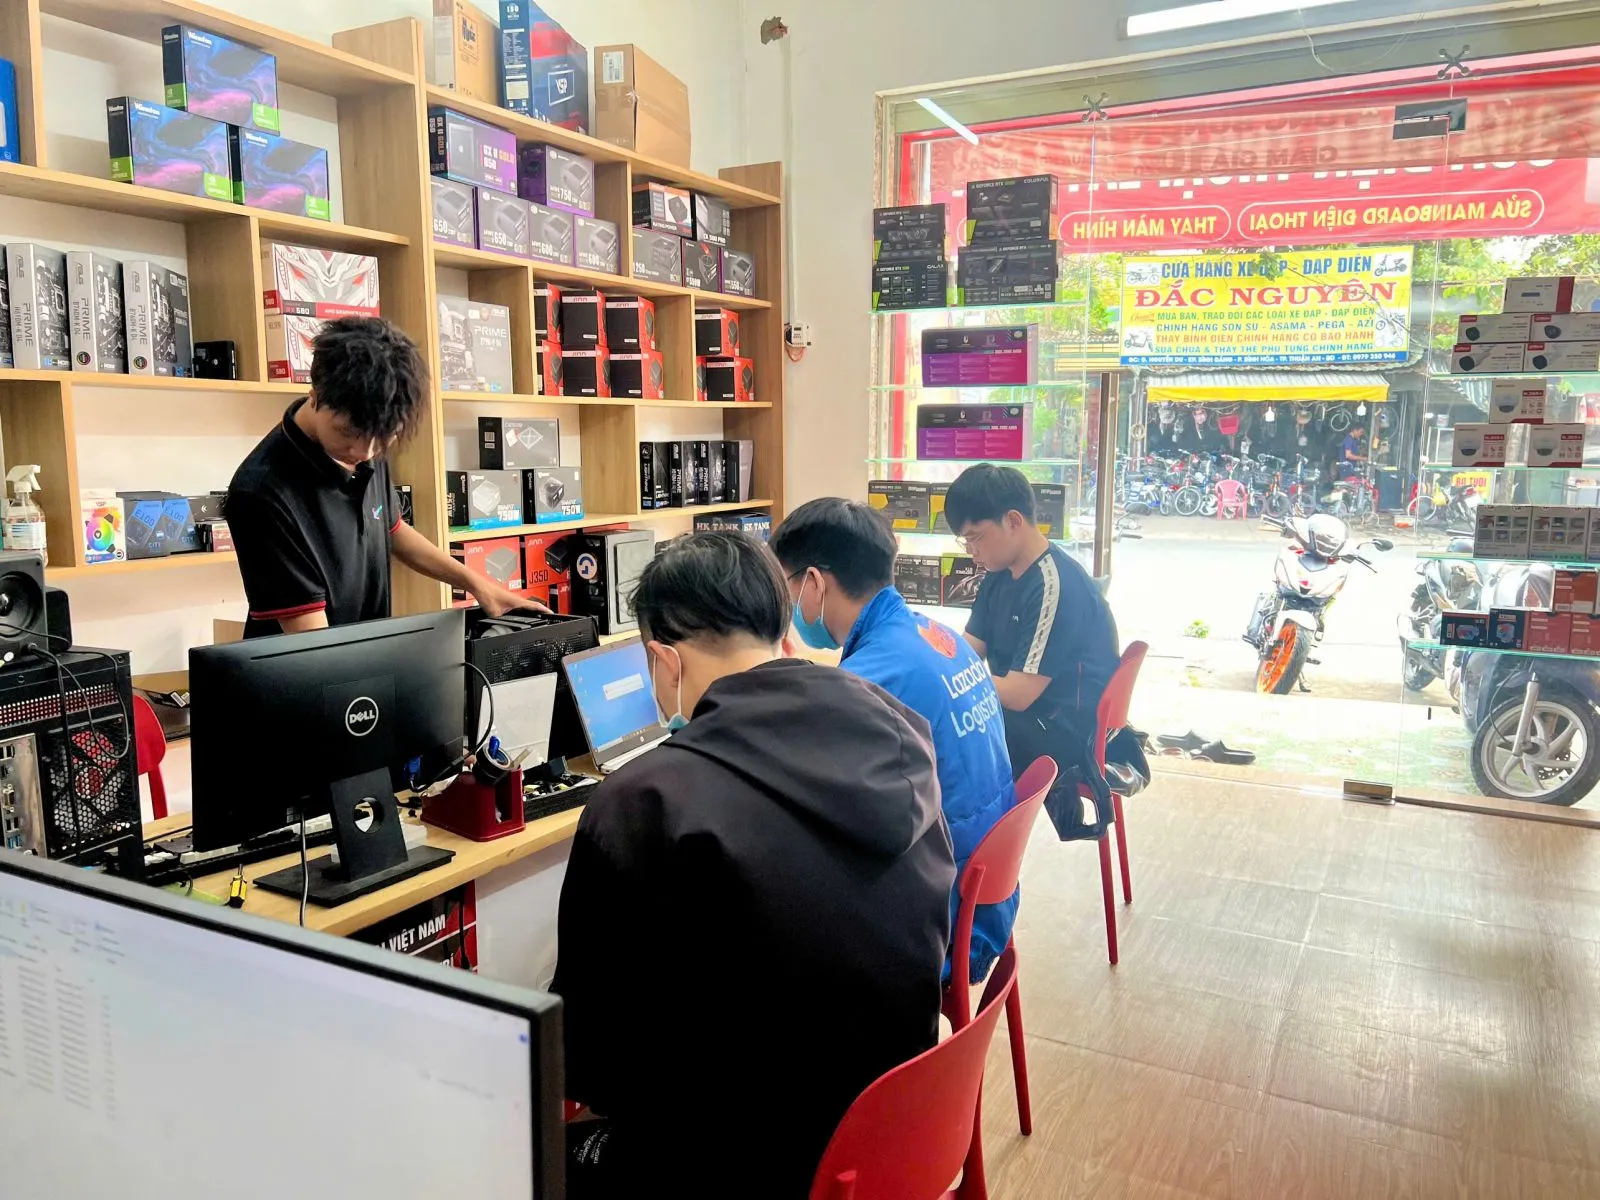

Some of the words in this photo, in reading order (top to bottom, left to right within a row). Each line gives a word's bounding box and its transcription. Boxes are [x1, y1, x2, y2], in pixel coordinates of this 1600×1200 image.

[1229, 278, 1397, 306] NGUYÊN
[81, 297, 91, 341] PRIME
[296, 307, 310, 315] 580
[23, 302, 34, 348] PRIME
[137, 304, 149, 346] PRIME
[473, 325, 507, 338] PRIME
[1270, 322, 1306, 331] ASAMA
[1318, 320, 1345, 329] PEGA
[498, 509, 520, 521] 750W
[561, 504, 581, 516] 750W
[134, 508, 155, 529] E100
[712, 522, 740, 531] TANK
[753, 521, 770, 531] TANK
[529, 569, 549, 584] J350
[941, 656, 987, 700] Lazada
[349, 708, 376, 725] DELL
[389, 928, 415, 951] VIỆT
[418, 914, 446, 940] NAM
